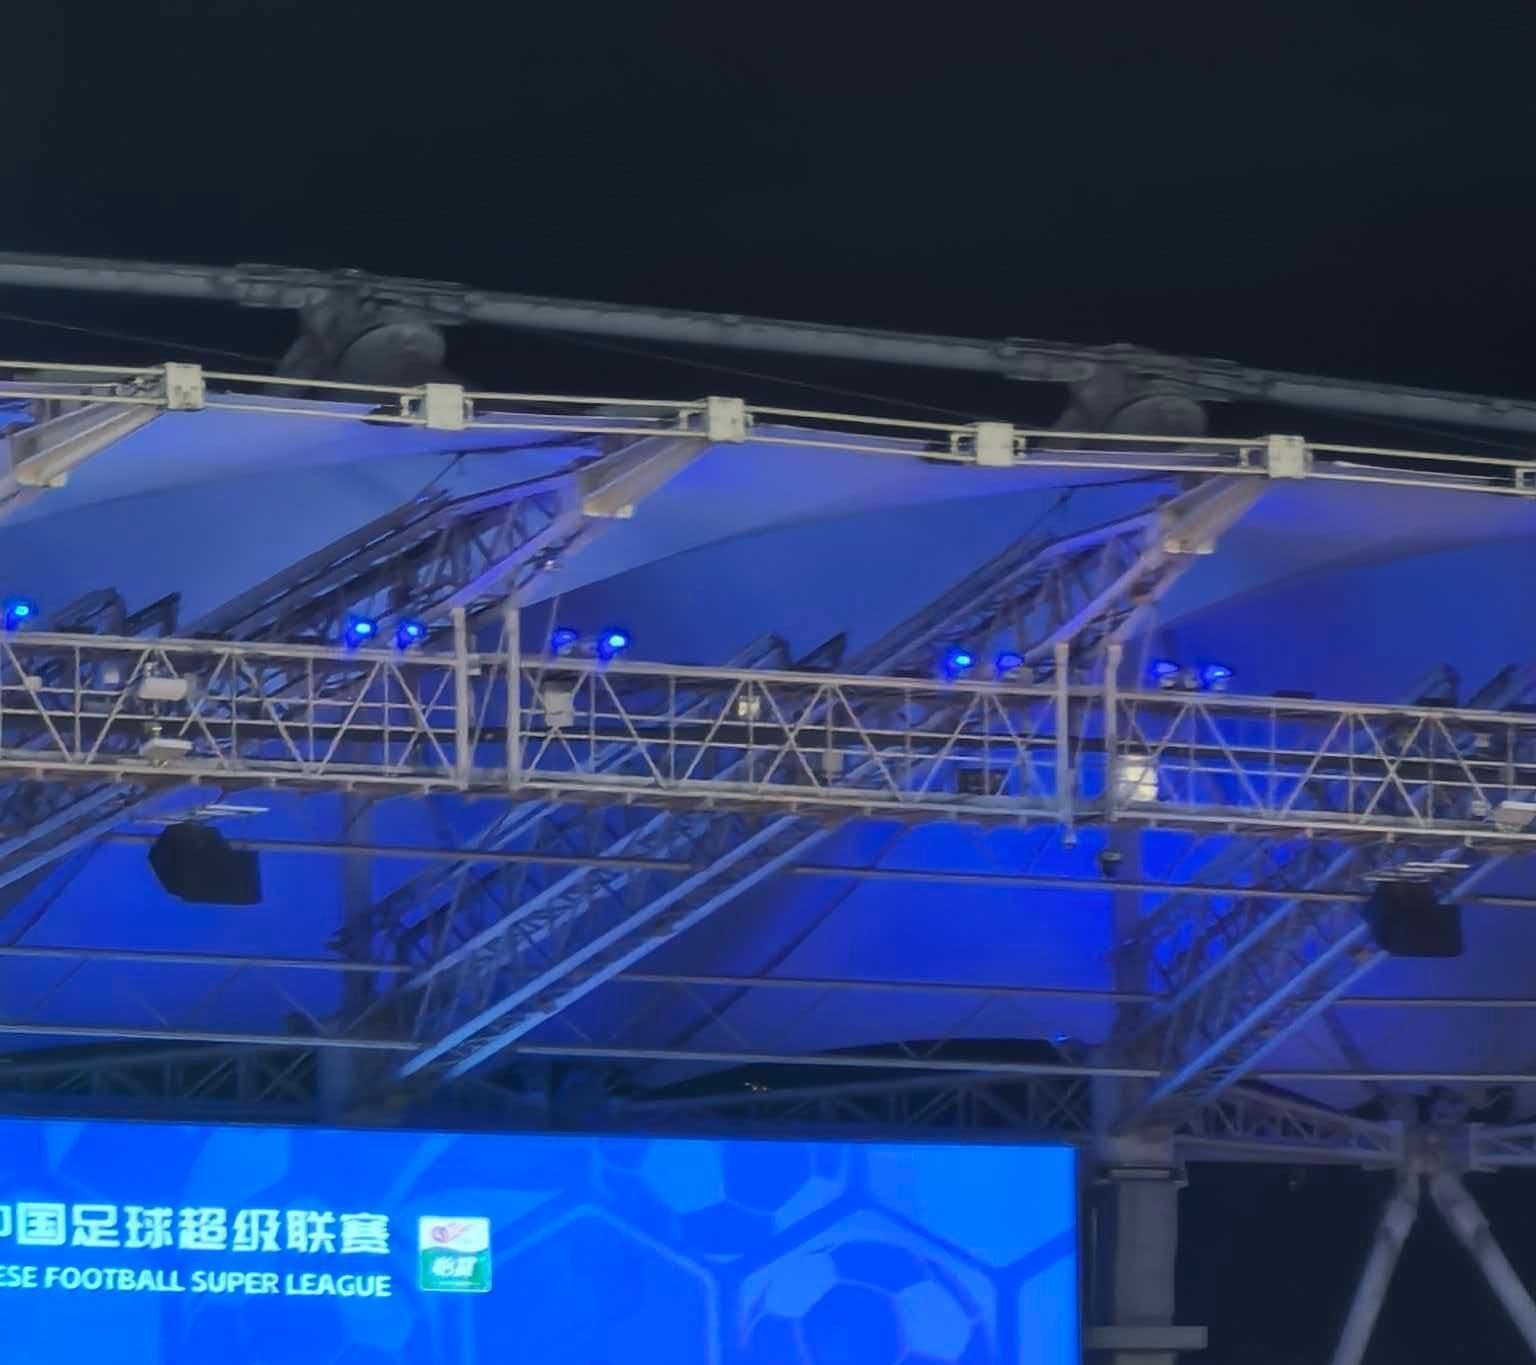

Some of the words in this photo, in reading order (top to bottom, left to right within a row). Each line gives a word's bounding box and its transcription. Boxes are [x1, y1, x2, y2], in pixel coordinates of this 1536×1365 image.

[44, 1267, 186, 1293] FOOTBALL
[191, 1271, 280, 1295] SUPER
[286, 1273, 392, 1299] LEAGUE
